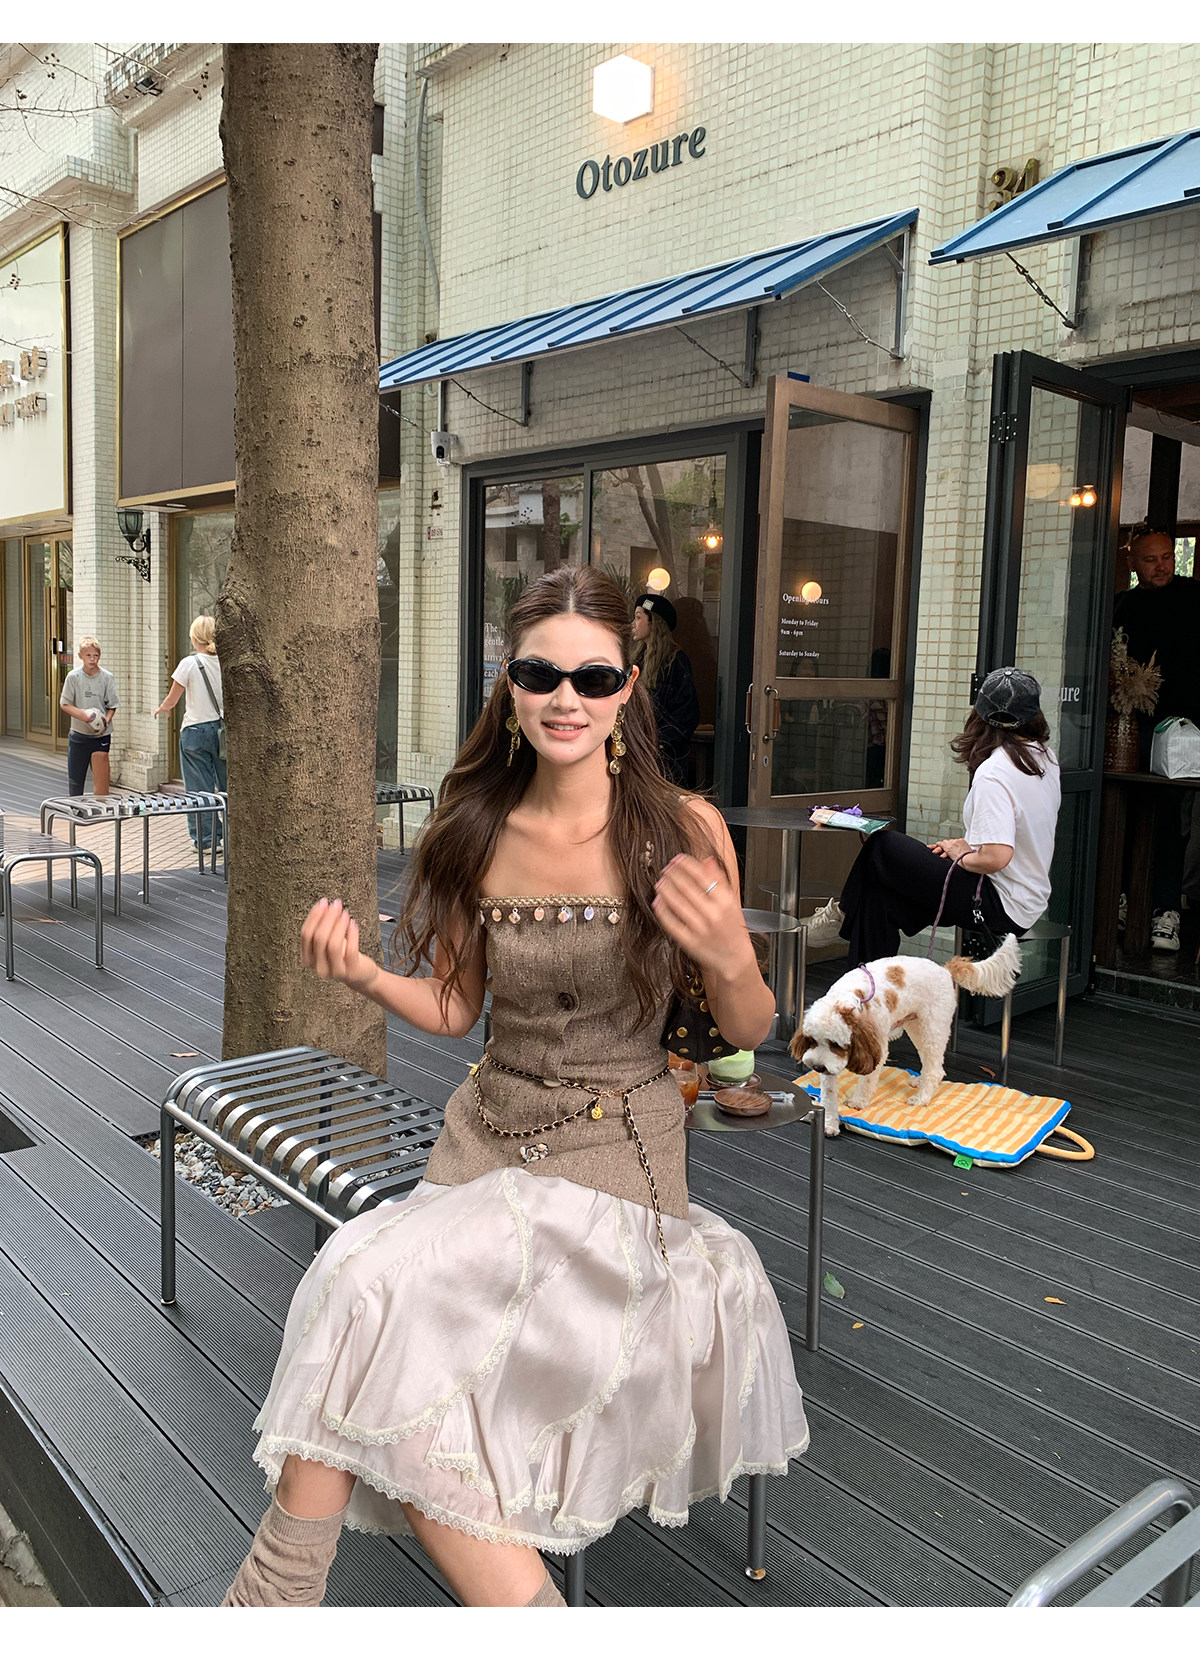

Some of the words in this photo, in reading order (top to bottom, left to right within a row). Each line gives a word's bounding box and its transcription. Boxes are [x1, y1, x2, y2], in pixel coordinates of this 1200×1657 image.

[576, 126, 707, 199] Otozure
[988, 158, 1041, 212] 34
[782, 593, 809, 605] Opening
[484, 622, 498, 632] The
[781, 618, 799, 627] Monday
[804, 619, 819, 628] Friday
[484, 637, 504, 648] gentle
[779, 650, 798, 658] Saturday
[804, 651, 820, 659] Sunday
[484, 669, 499, 678] each
